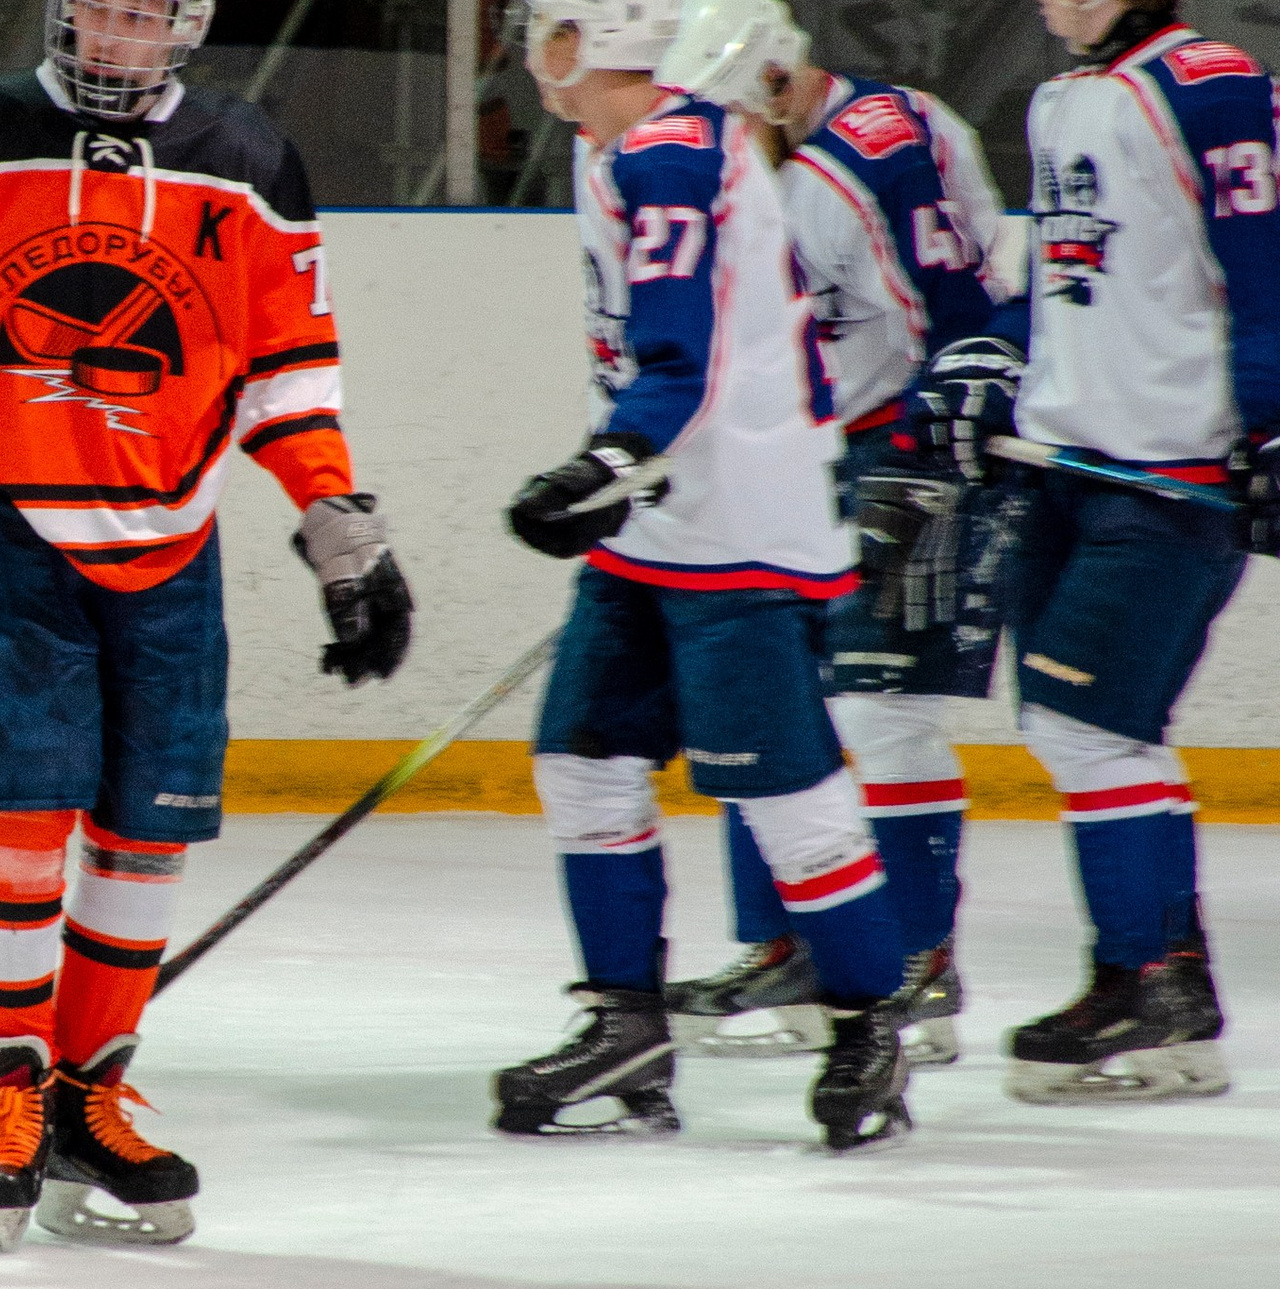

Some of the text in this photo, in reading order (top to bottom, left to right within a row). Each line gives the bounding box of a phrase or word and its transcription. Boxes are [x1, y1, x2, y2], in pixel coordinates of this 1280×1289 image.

[1203, 140, 1277, 220] 13
[0, 230, 193, 300] ЛЕДОРУБЫ
[626, 204, 708, 285] 27
